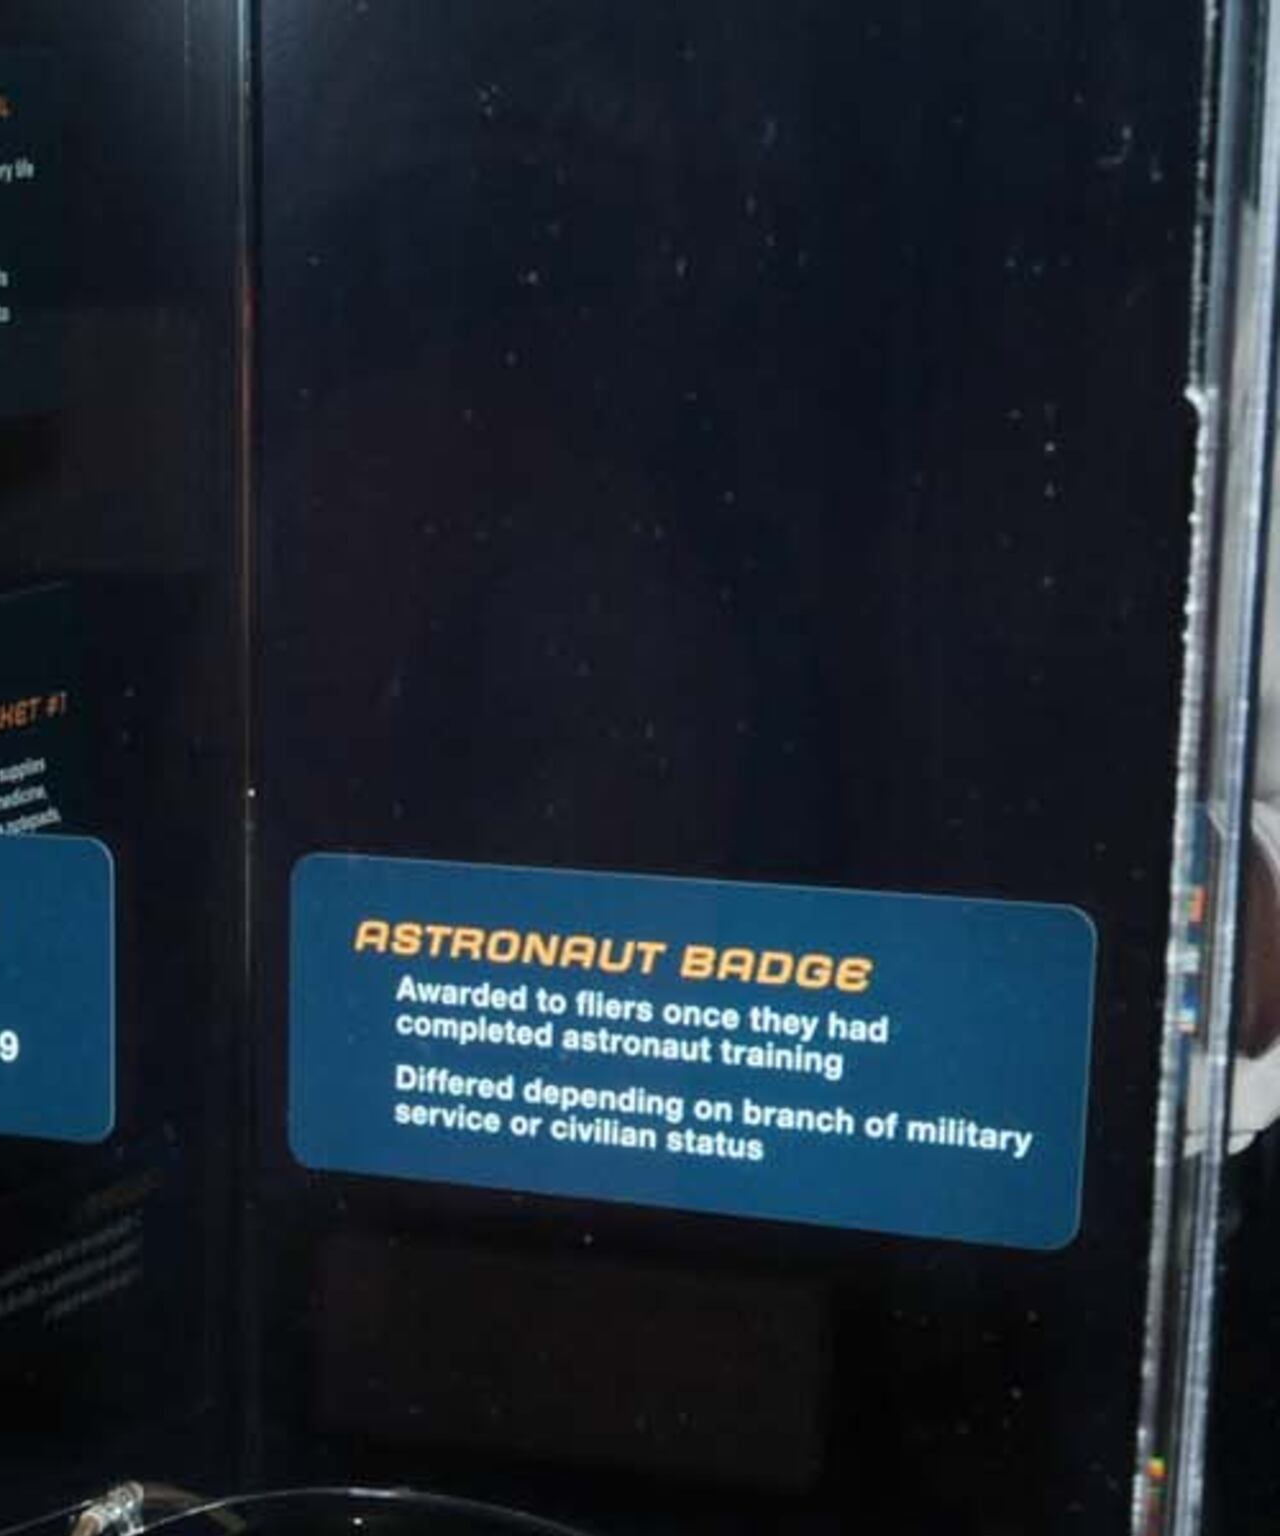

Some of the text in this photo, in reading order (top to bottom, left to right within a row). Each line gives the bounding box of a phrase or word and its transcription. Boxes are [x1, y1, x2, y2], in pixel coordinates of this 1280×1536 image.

[16, 157, 34, 178] life
[45, 691, 68, 717] #1
[354, 920, 873, 992] ASTRONAUT BADGE
[395, 974, 889, 1044] Awarded to fliers once they had
[395, 1014, 844, 1081] completed astronaut training
[394, 1102, 764, 1161] service or civilian status
[395, 1063, 1033, 1159] Differed depending on branch of military
